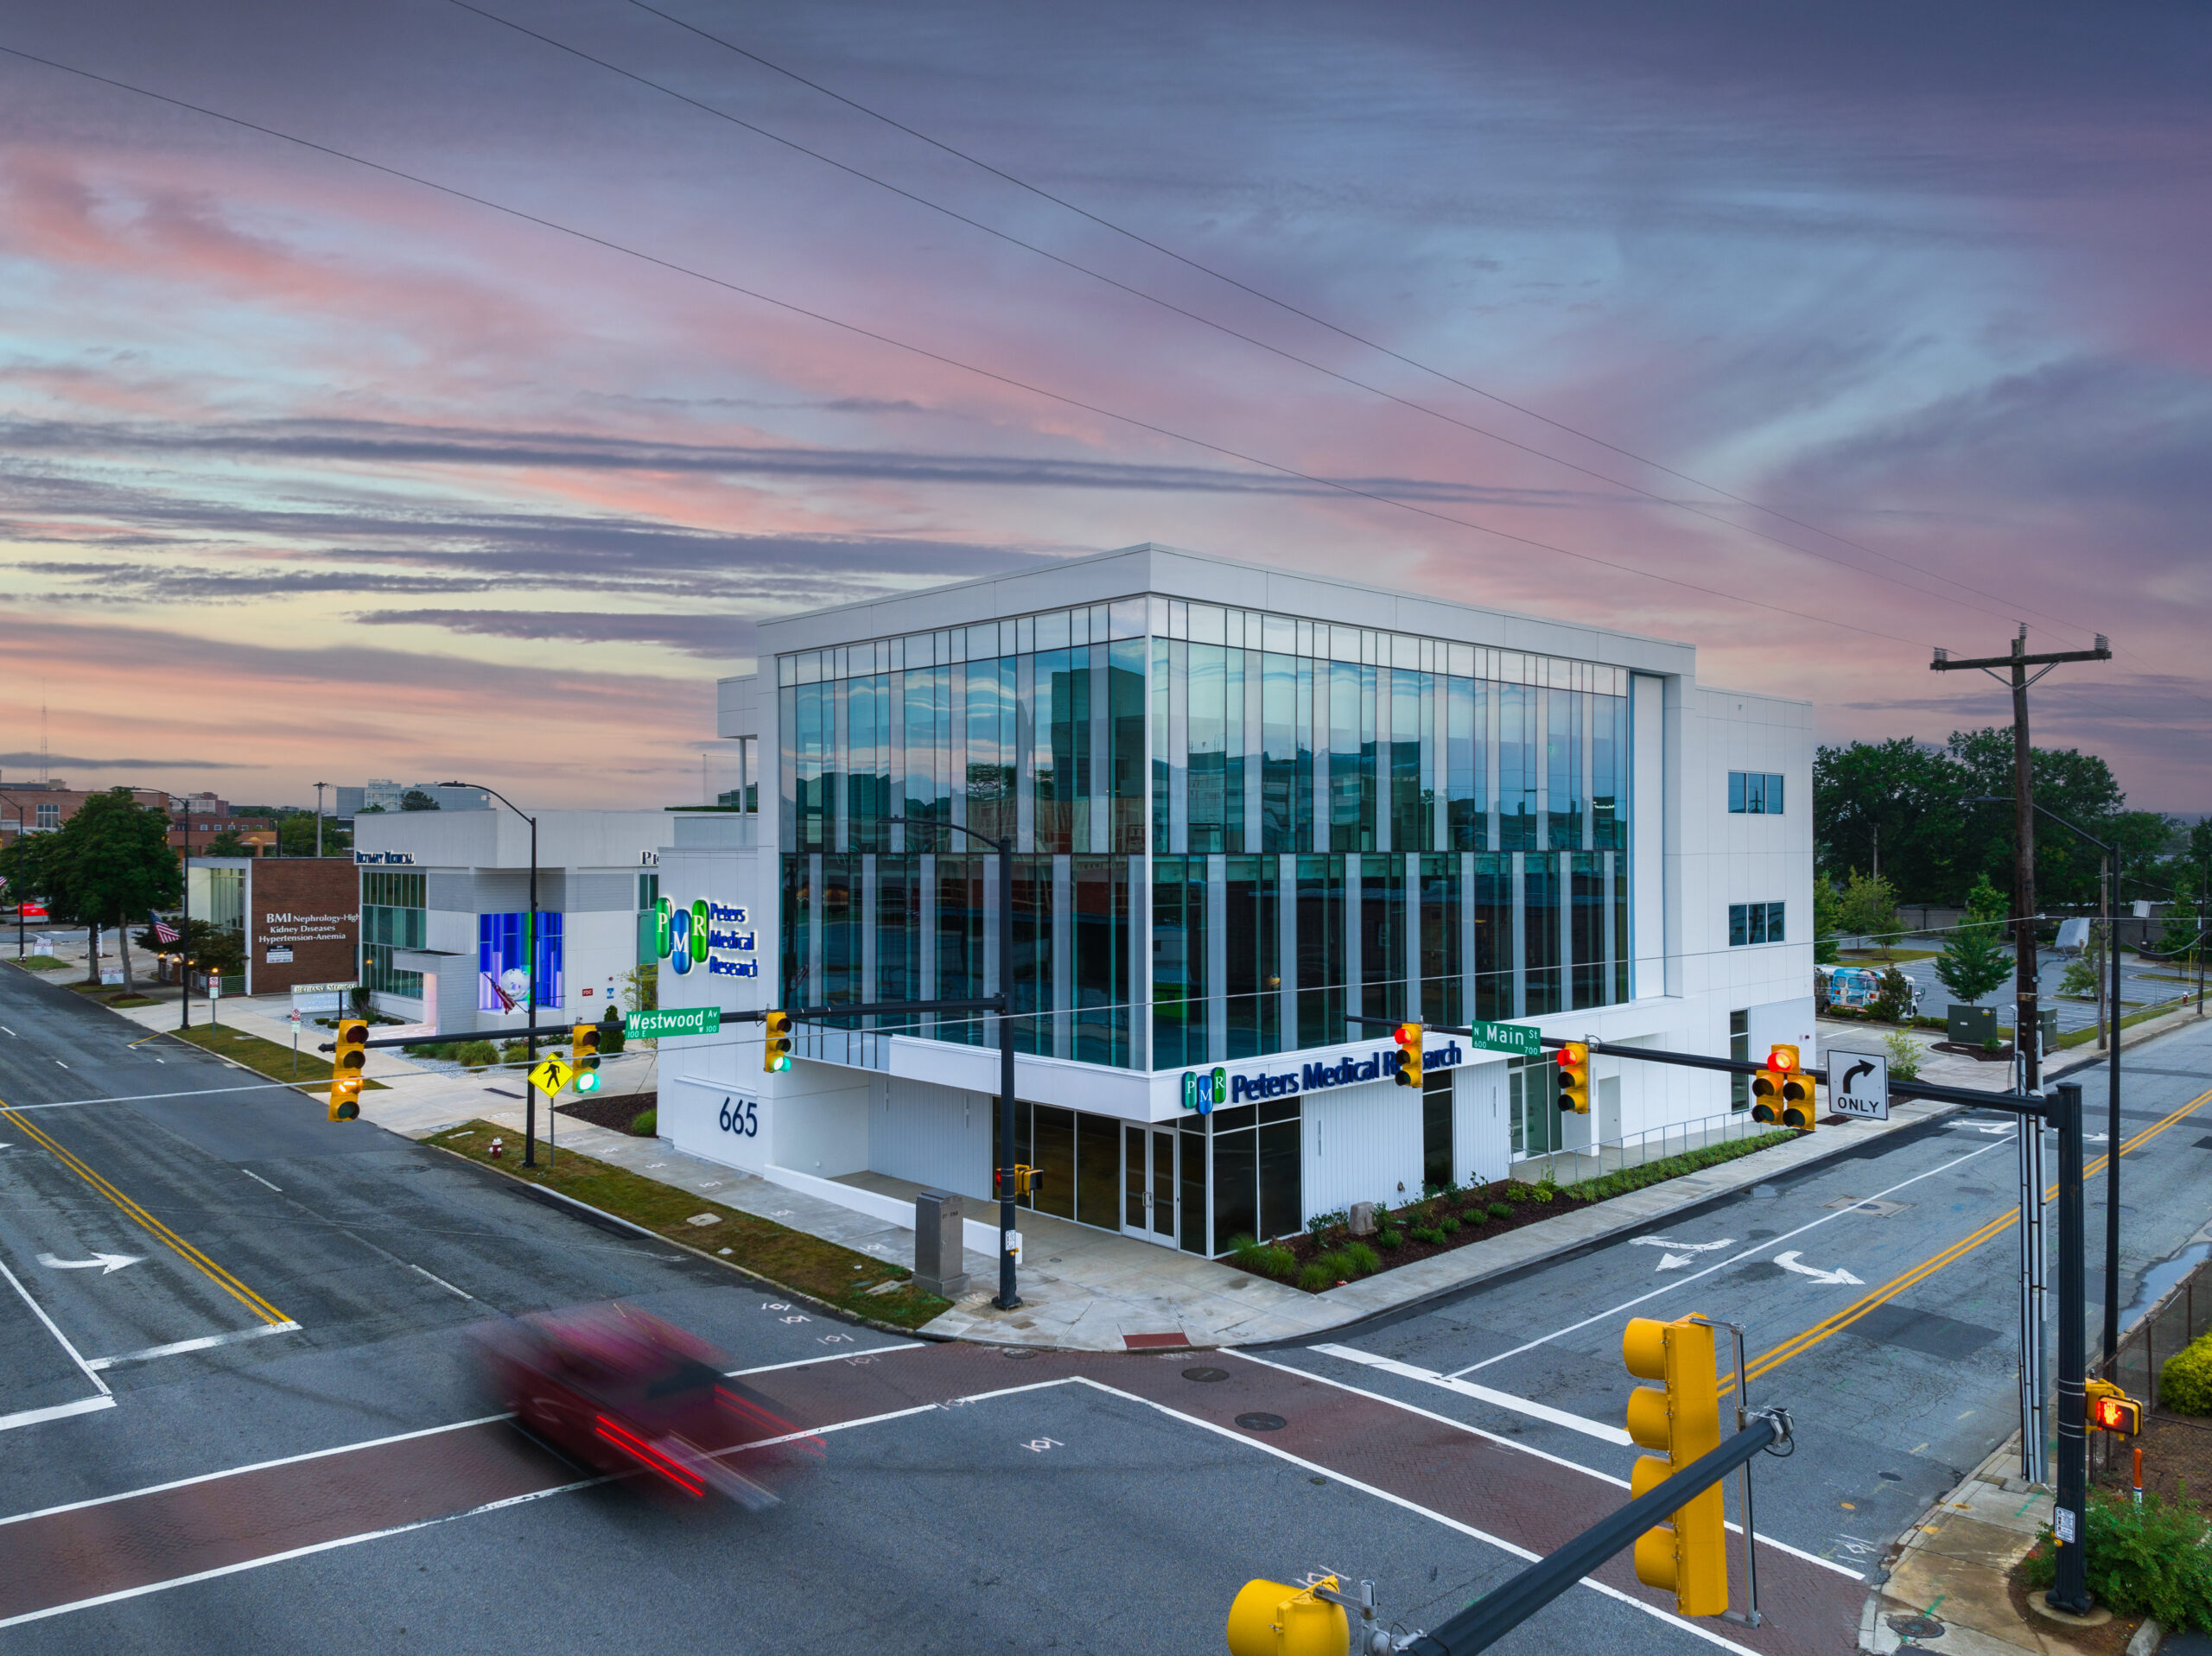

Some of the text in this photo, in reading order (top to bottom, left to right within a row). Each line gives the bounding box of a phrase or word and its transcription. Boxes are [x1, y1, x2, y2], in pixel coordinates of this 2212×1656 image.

[266, 912, 292, 923] BMI
[709, 903, 746, 923] Peters
[258, 933, 346, 944] Hypertension-Anemia
[270, 924, 336, 934] Kidney Diseases
[709, 930, 754, 951] Medical
[709, 955, 758, 977] Research
[629, 1010, 718, 1031] Westwood Av
[1474, 1024, 1538, 1046] N Main St
[1474, 1040, 1538, 1056] 600 700
[1232, 1072, 1300, 1103] Peters
[1303, 1051, 1380, 1090] Medical
[1837, 1096, 1879, 1114] ONLY
[719, 1095, 758, 1138] 665
